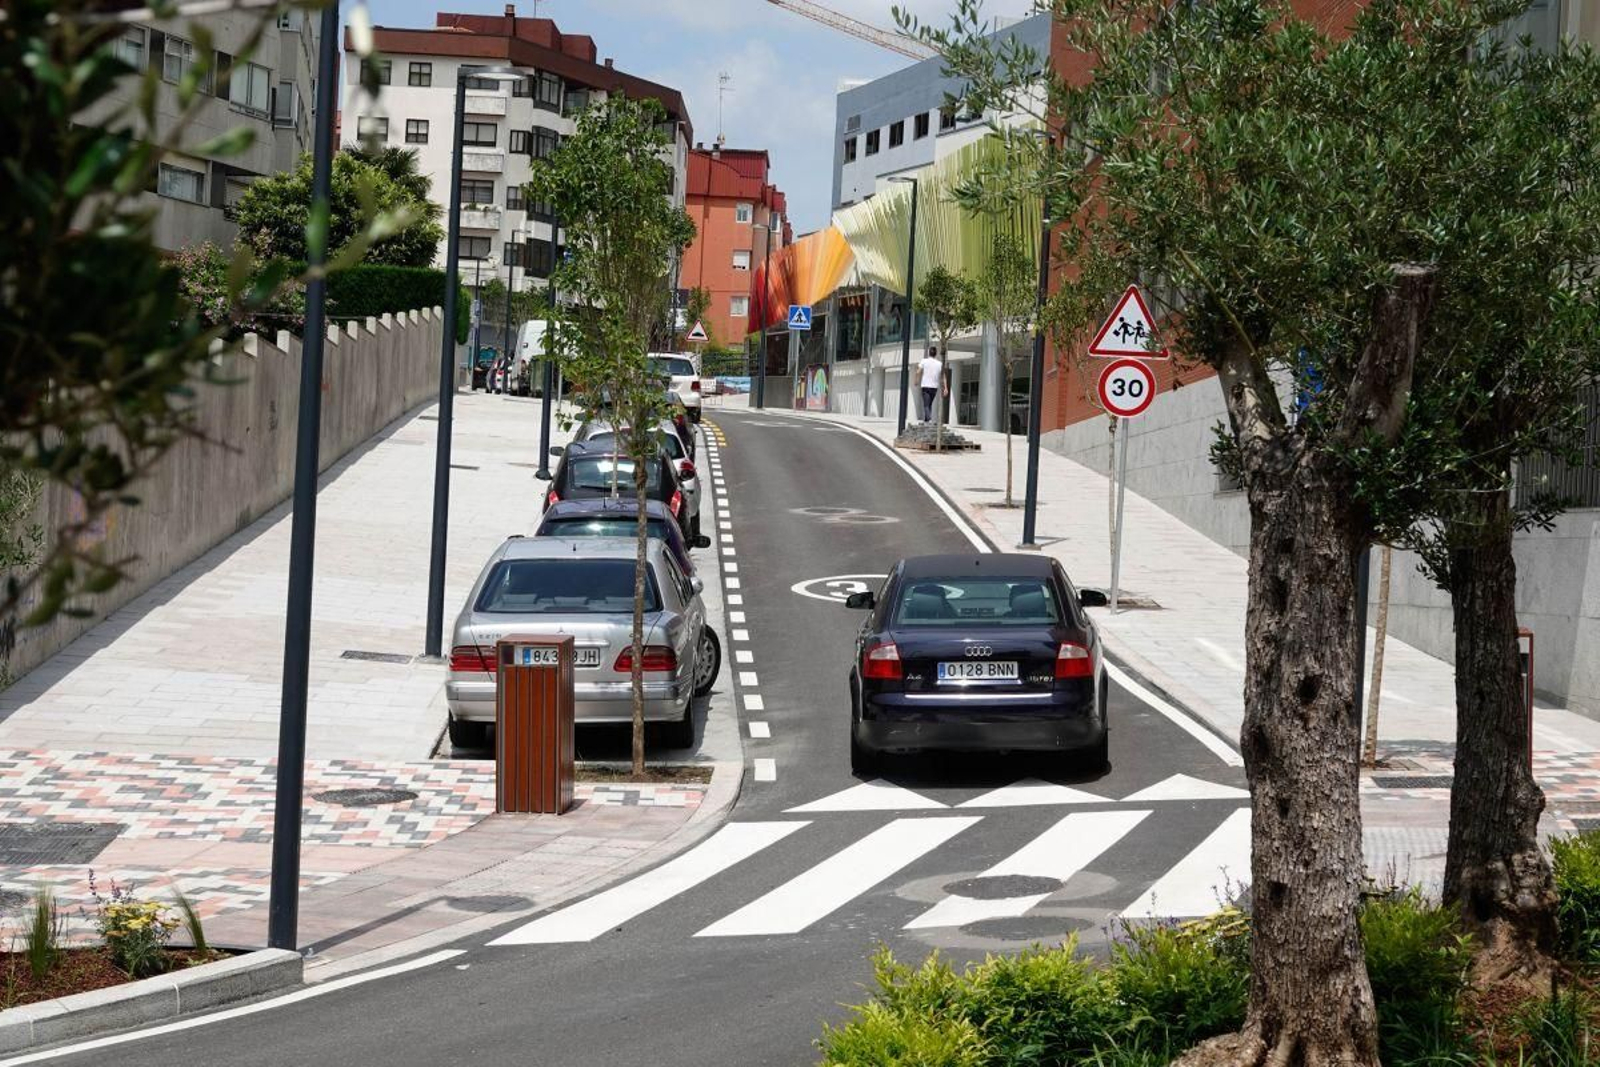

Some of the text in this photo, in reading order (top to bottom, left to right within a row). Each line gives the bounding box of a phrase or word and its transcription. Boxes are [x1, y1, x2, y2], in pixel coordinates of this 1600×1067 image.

[1112, 378, 1143, 398] 30
[534, 651, 564, 663] 843
[948, 664, 1015, 677] 0128 BNN
